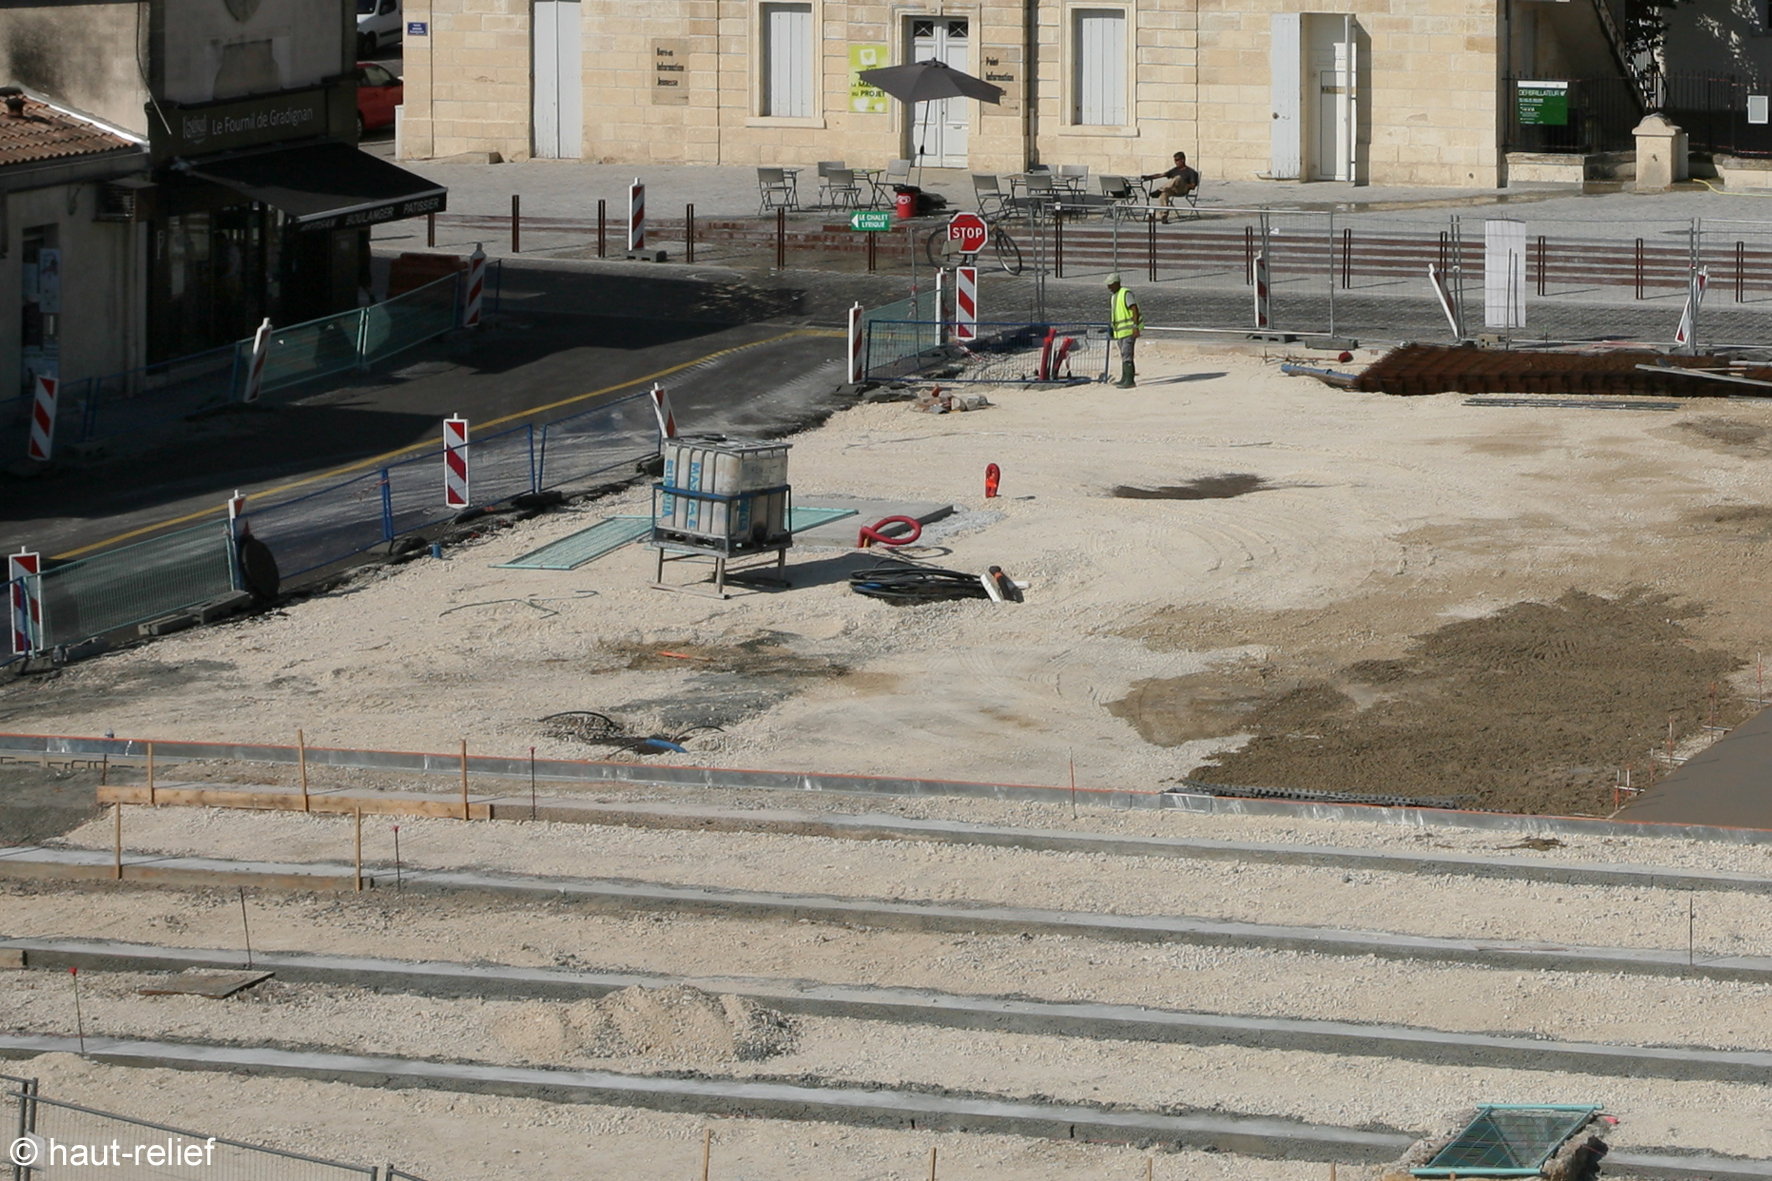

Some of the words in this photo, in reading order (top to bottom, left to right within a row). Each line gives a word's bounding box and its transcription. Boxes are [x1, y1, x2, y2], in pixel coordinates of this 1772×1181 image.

[657, 61, 684, 71] Information
[986, 71, 1014, 81] Information
[212, 119, 223, 135] Le
[225, 112, 255, 133] Fournil
[256, 111, 268, 128] de
[269, 107, 313, 127] Gradignan
[345, 206, 394, 226] BOULANGER
[403, 198, 440, 215] PATISSIER
[952, 227, 983, 239] STOP
